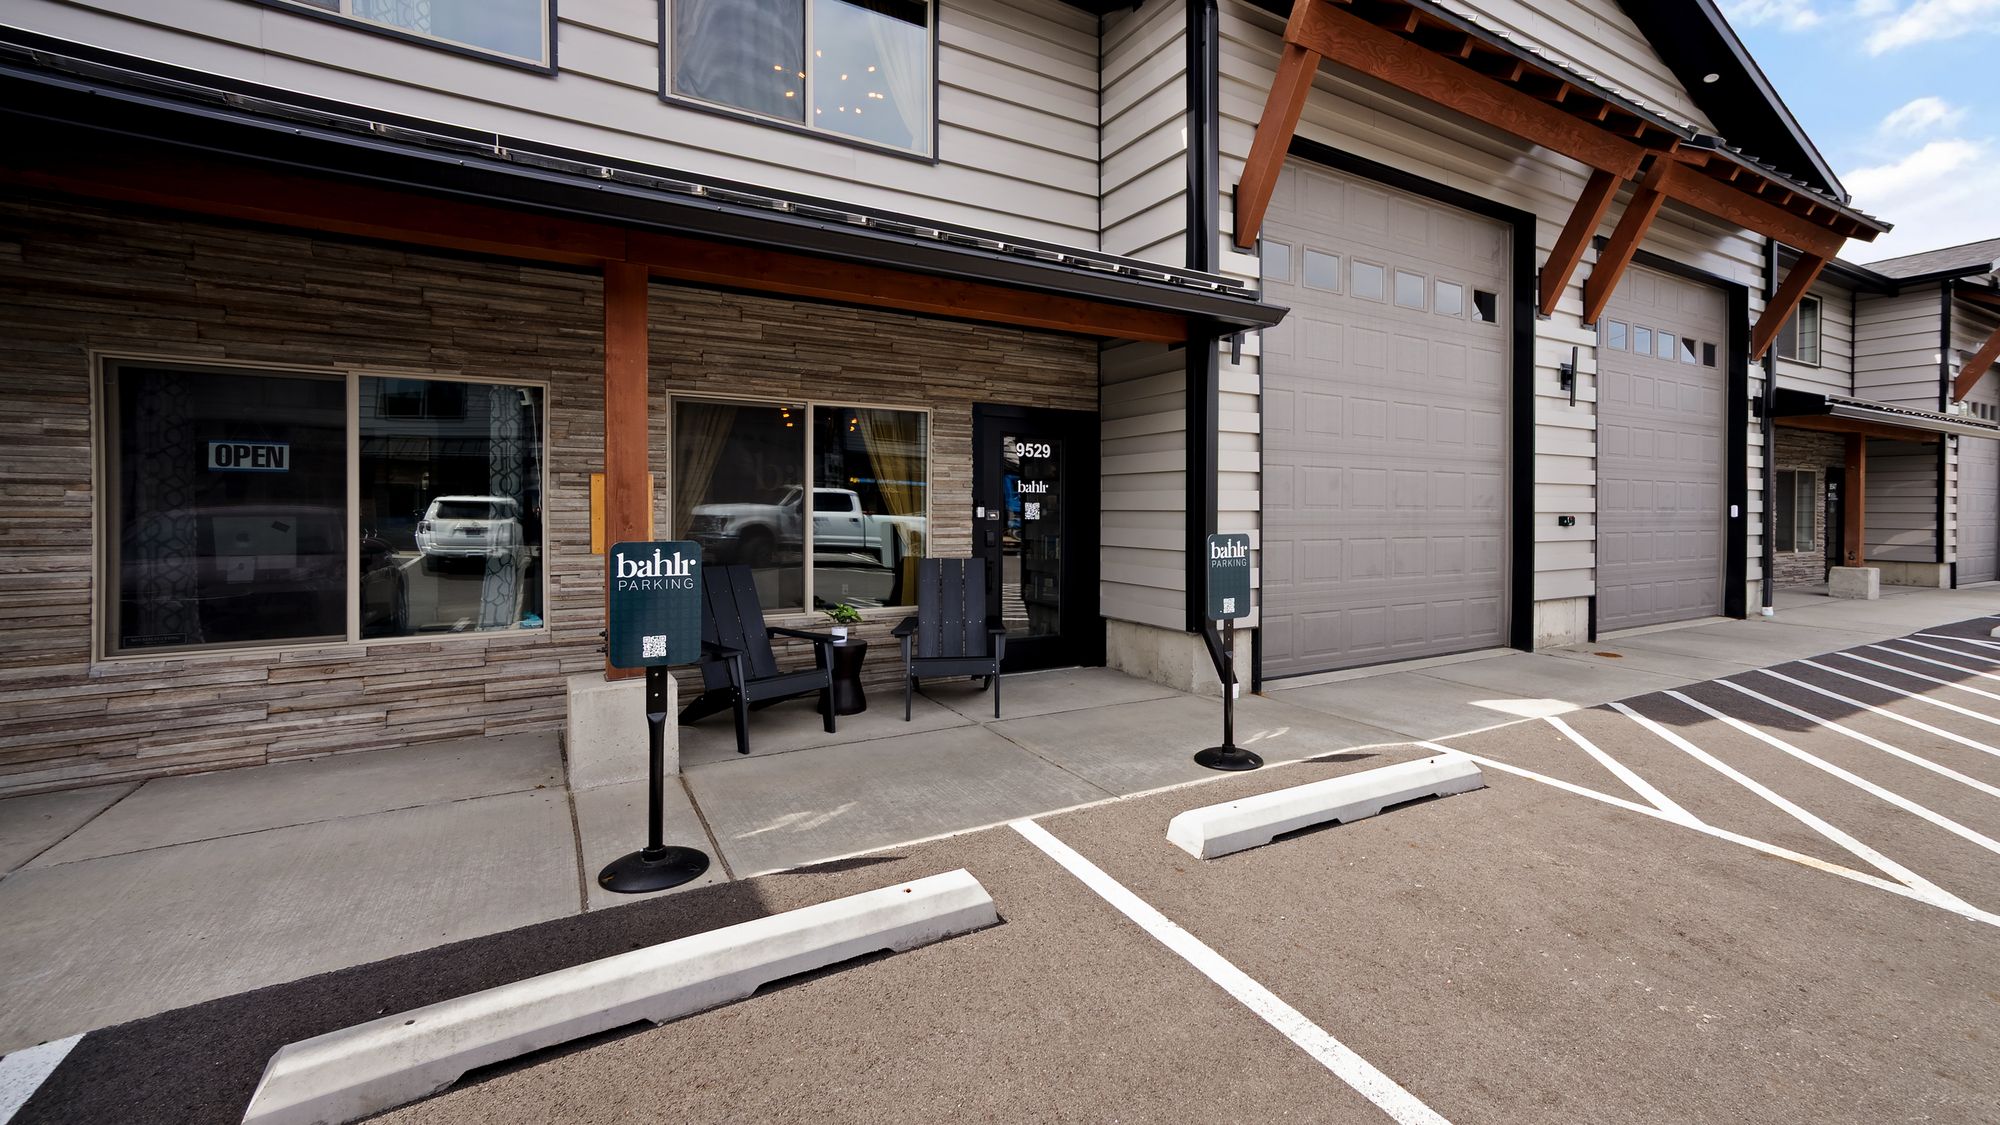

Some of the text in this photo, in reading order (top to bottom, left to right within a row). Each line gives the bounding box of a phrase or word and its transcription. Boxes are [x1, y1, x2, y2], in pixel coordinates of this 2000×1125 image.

[215, 444, 284, 468] OPEN
[1016, 442, 1051, 458] 9529
[1017, 480, 1049, 493] bahlr
[1210, 538, 1248, 559] bahlr
[616, 548, 697, 578] bahlr
[1211, 558, 1247, 568] PARKING
[618, 578, 694, 591] PARKING
